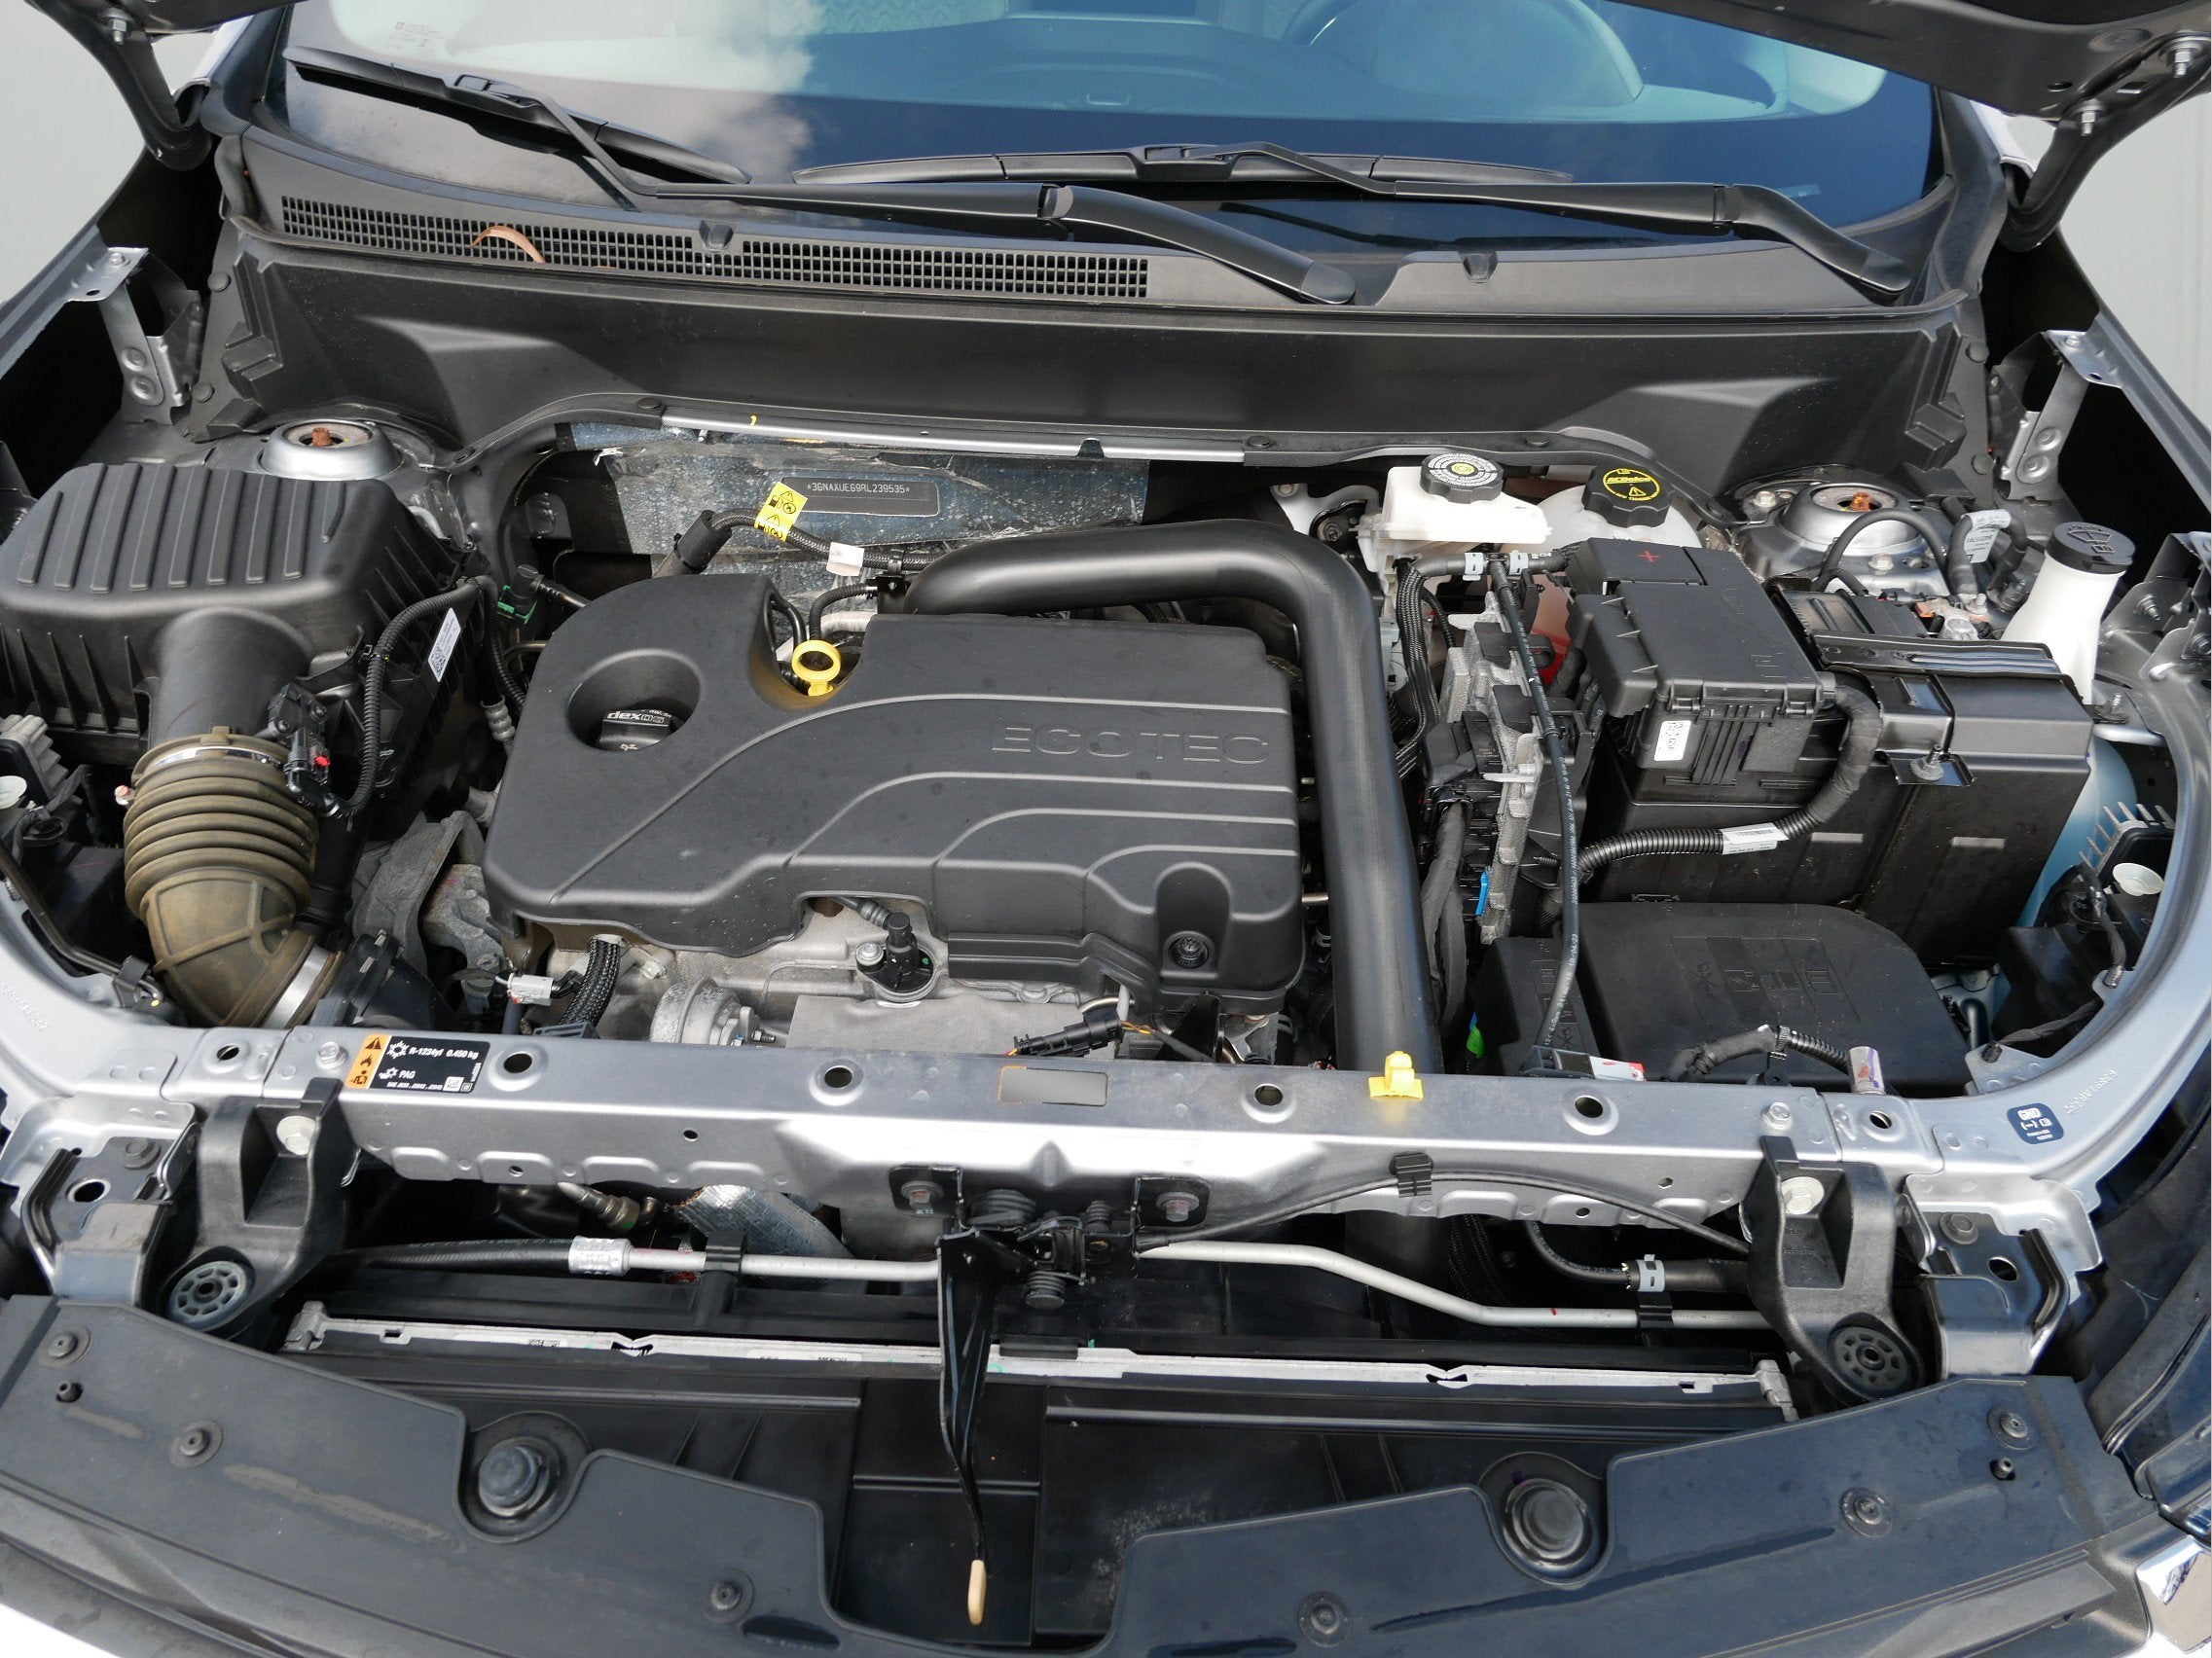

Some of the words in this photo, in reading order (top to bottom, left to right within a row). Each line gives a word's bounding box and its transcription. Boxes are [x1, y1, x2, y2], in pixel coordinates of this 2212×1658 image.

[607, 711, 665, 723] dexos
[991, 724, 1269, 766] ECOTEC
[409, 1048, 444, 1058] R-1234yf
[469, 1051, 479, 1060] kg
[399, 1070, 416, 1079] PAG
[2017, 1107, 2042, 1120] GND
